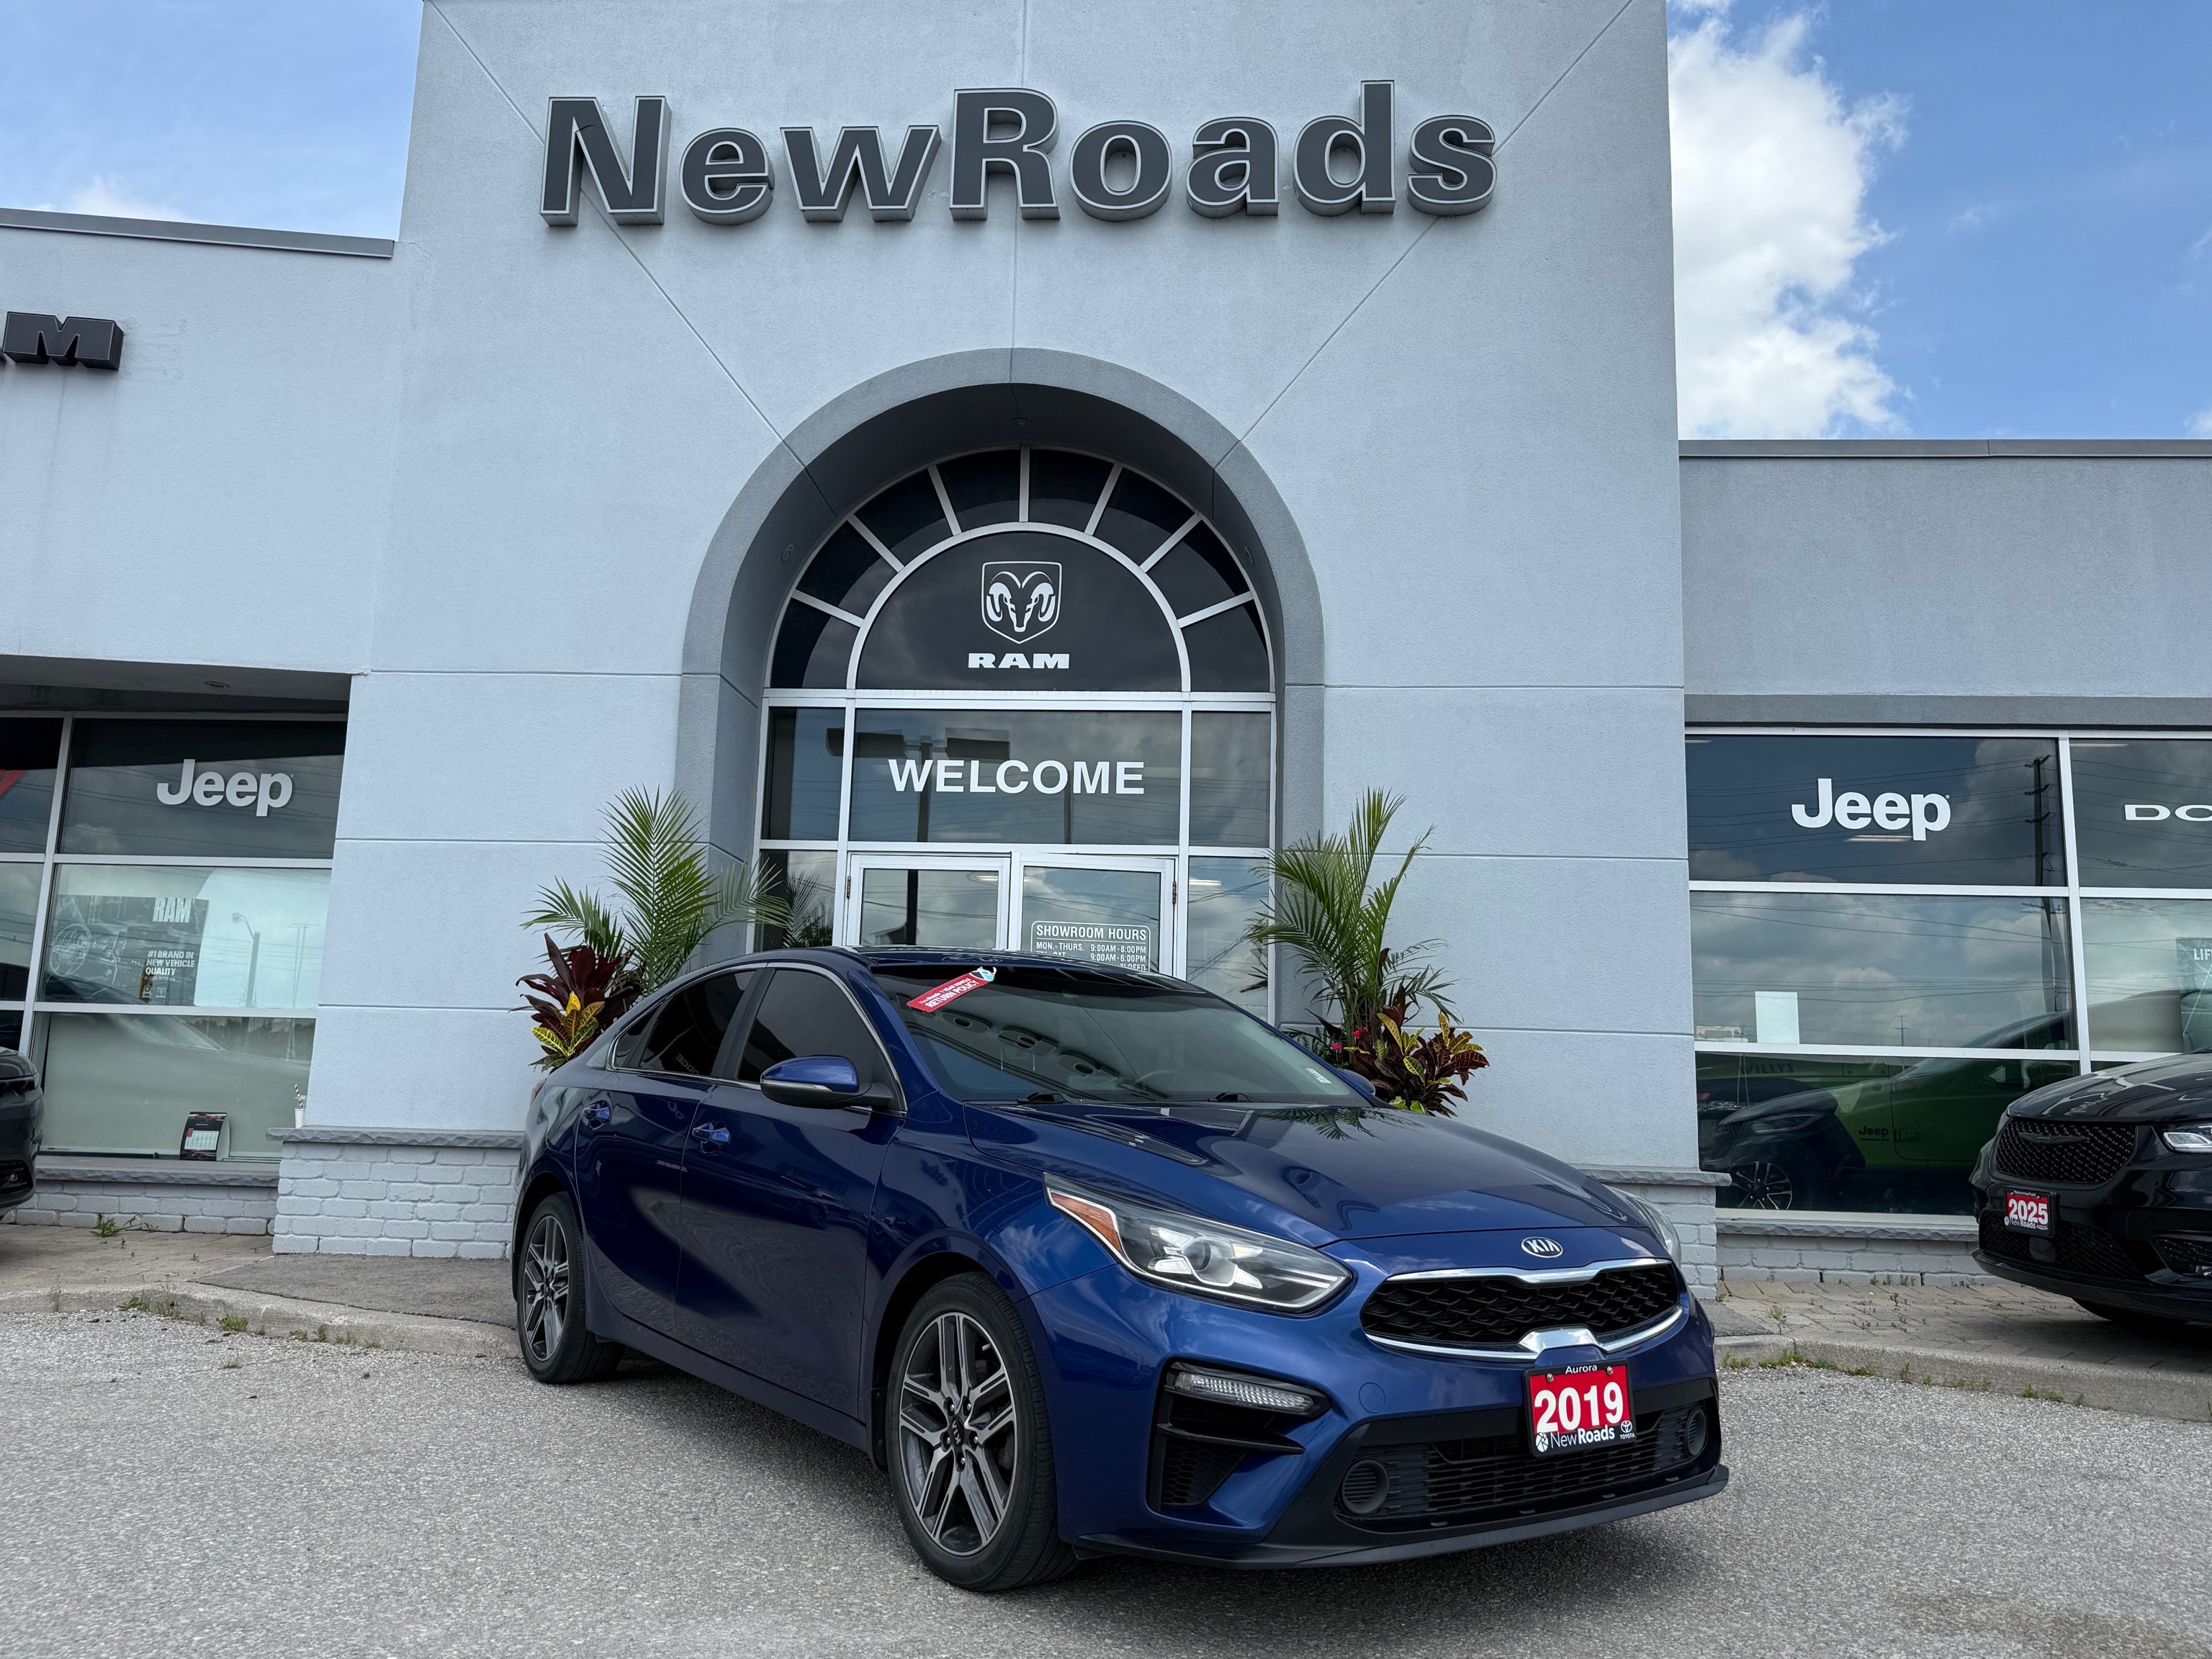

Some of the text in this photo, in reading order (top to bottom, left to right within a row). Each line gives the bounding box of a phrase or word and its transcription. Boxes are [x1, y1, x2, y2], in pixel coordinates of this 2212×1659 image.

[540, 80, 1498, 226] NewRoads
[968, 653, 1069, 669] RAM
[888, 759, 1145, 794] WELCOME
[156, 758, 293, 817] Jeep
[1791, 778, 1951, 841] Jeep
[2124, 804, 2212, 822] DO
[153, 898, 192, 922] RAM
[1036, 925, 1146, 940] SHOWROOM HOURS
[146, 958, 195, 968] NEW VEHICLE
[158, 950, 185, 959] BRAND
[2193, 948, 2212, 961] LIF
[145, 966, 176, 976] QUALITY
[925, 980, 979, 1008] RETURN POLICY
[1858, 1125, 1889, 1137] Jeep
[2009, 1198, 2049, 1225] 2025
[1526, 1239, 1560, 1253] KIA
[1565, 1364, 1597, 1375] Aurora
[1534, 1381, 1624, 1434] 2019
